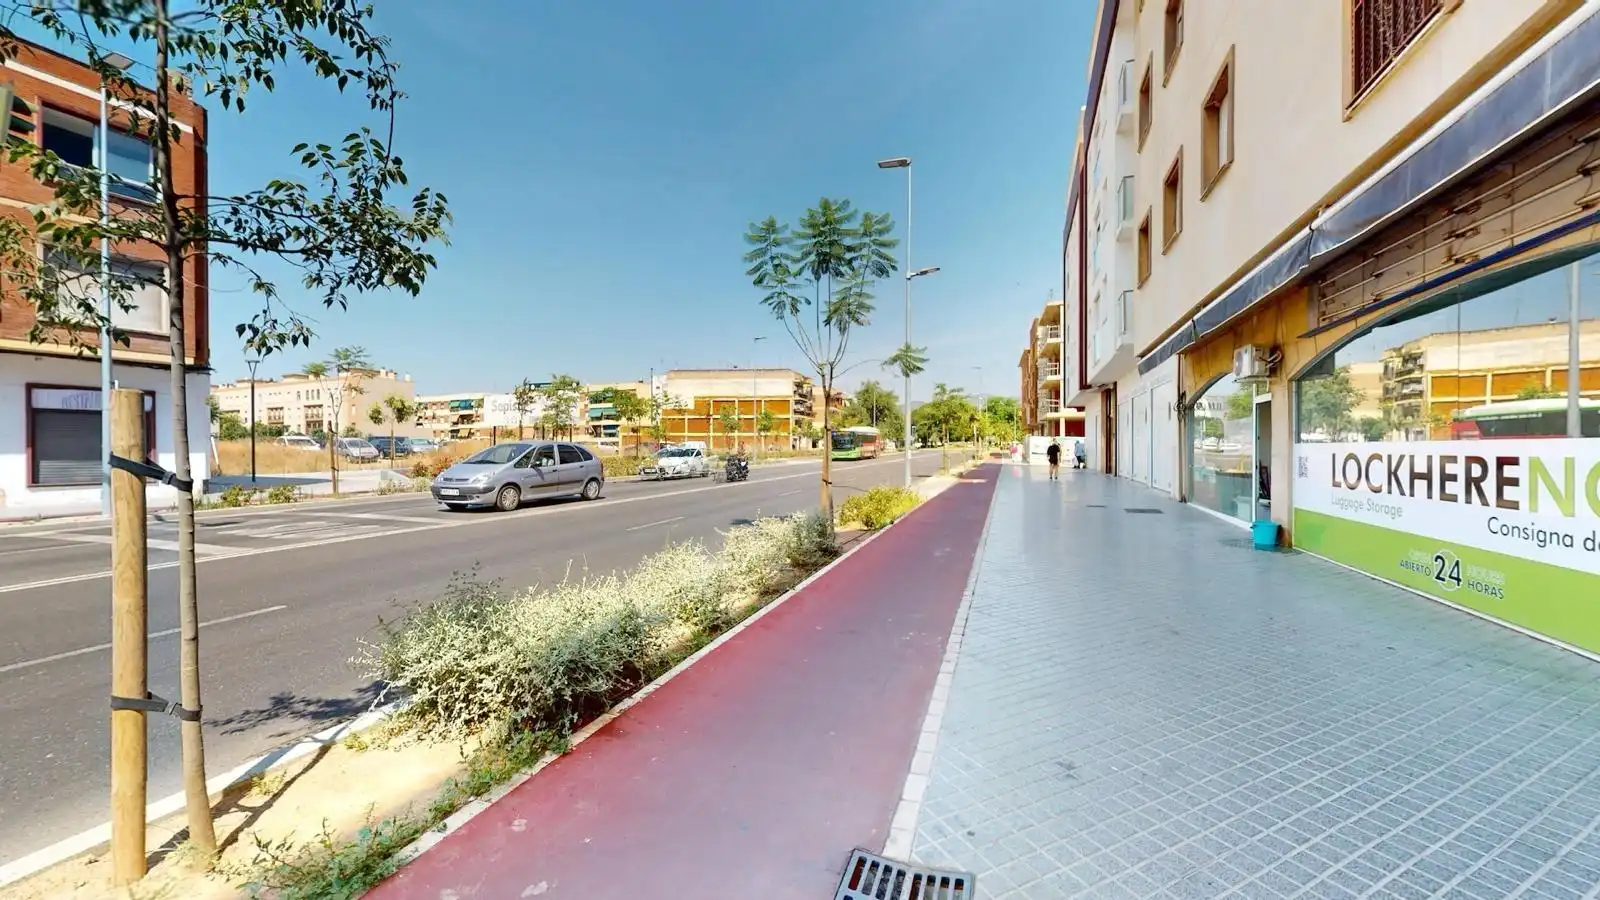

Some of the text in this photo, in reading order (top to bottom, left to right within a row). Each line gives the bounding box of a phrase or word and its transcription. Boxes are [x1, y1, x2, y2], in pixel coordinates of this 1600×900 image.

[1331, 491, 1403, 519] Luggage Storage
[1487, 516, 1600, 552] Consigna d
[1399, 559, 1432, 577] ABIERTO
[1434, 554, 1462, 587] 24
[1467, 579, 1505, 600] HORAS
